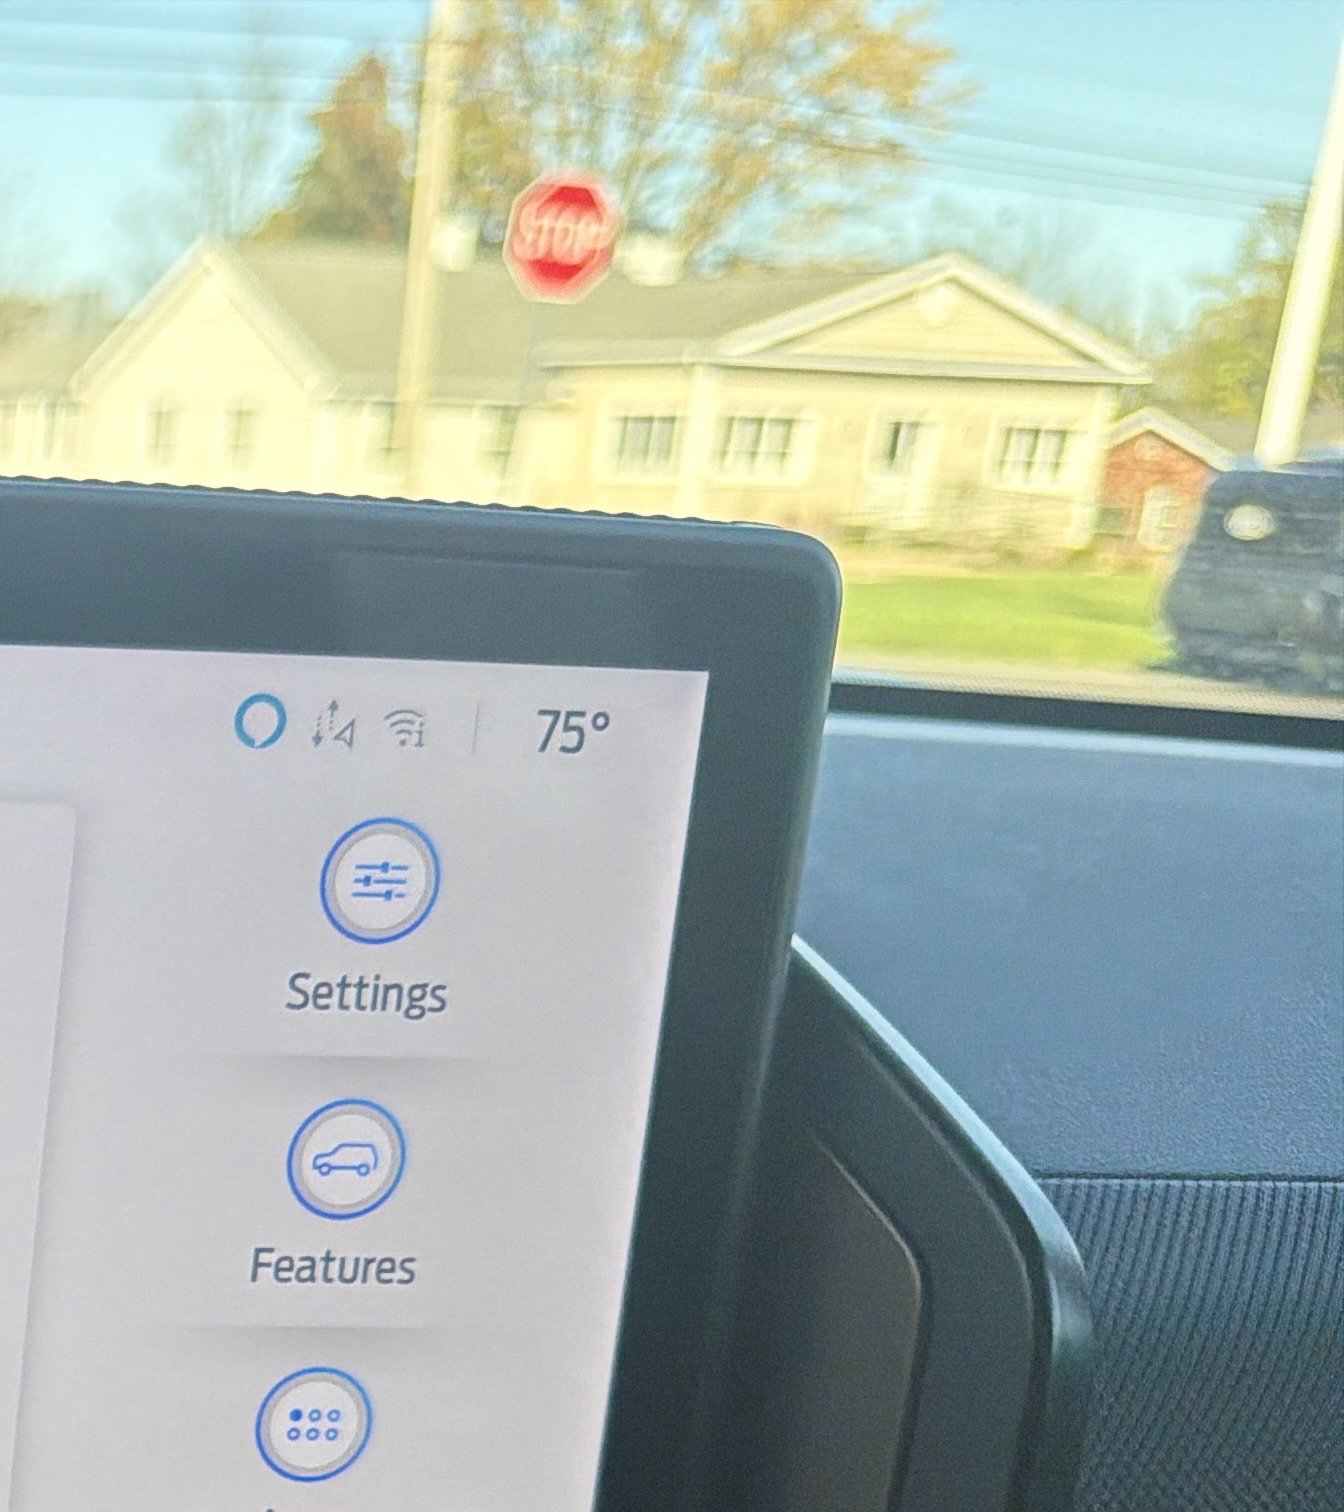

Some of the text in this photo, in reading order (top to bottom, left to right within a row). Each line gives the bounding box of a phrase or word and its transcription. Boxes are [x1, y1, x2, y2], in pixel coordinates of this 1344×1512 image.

[515, 200, 610, 264] STOP
[535, 708, 611, 754] 75°
[285, 972, 448, 1020] Settings
[250, 1246, 417, 1285] Features
